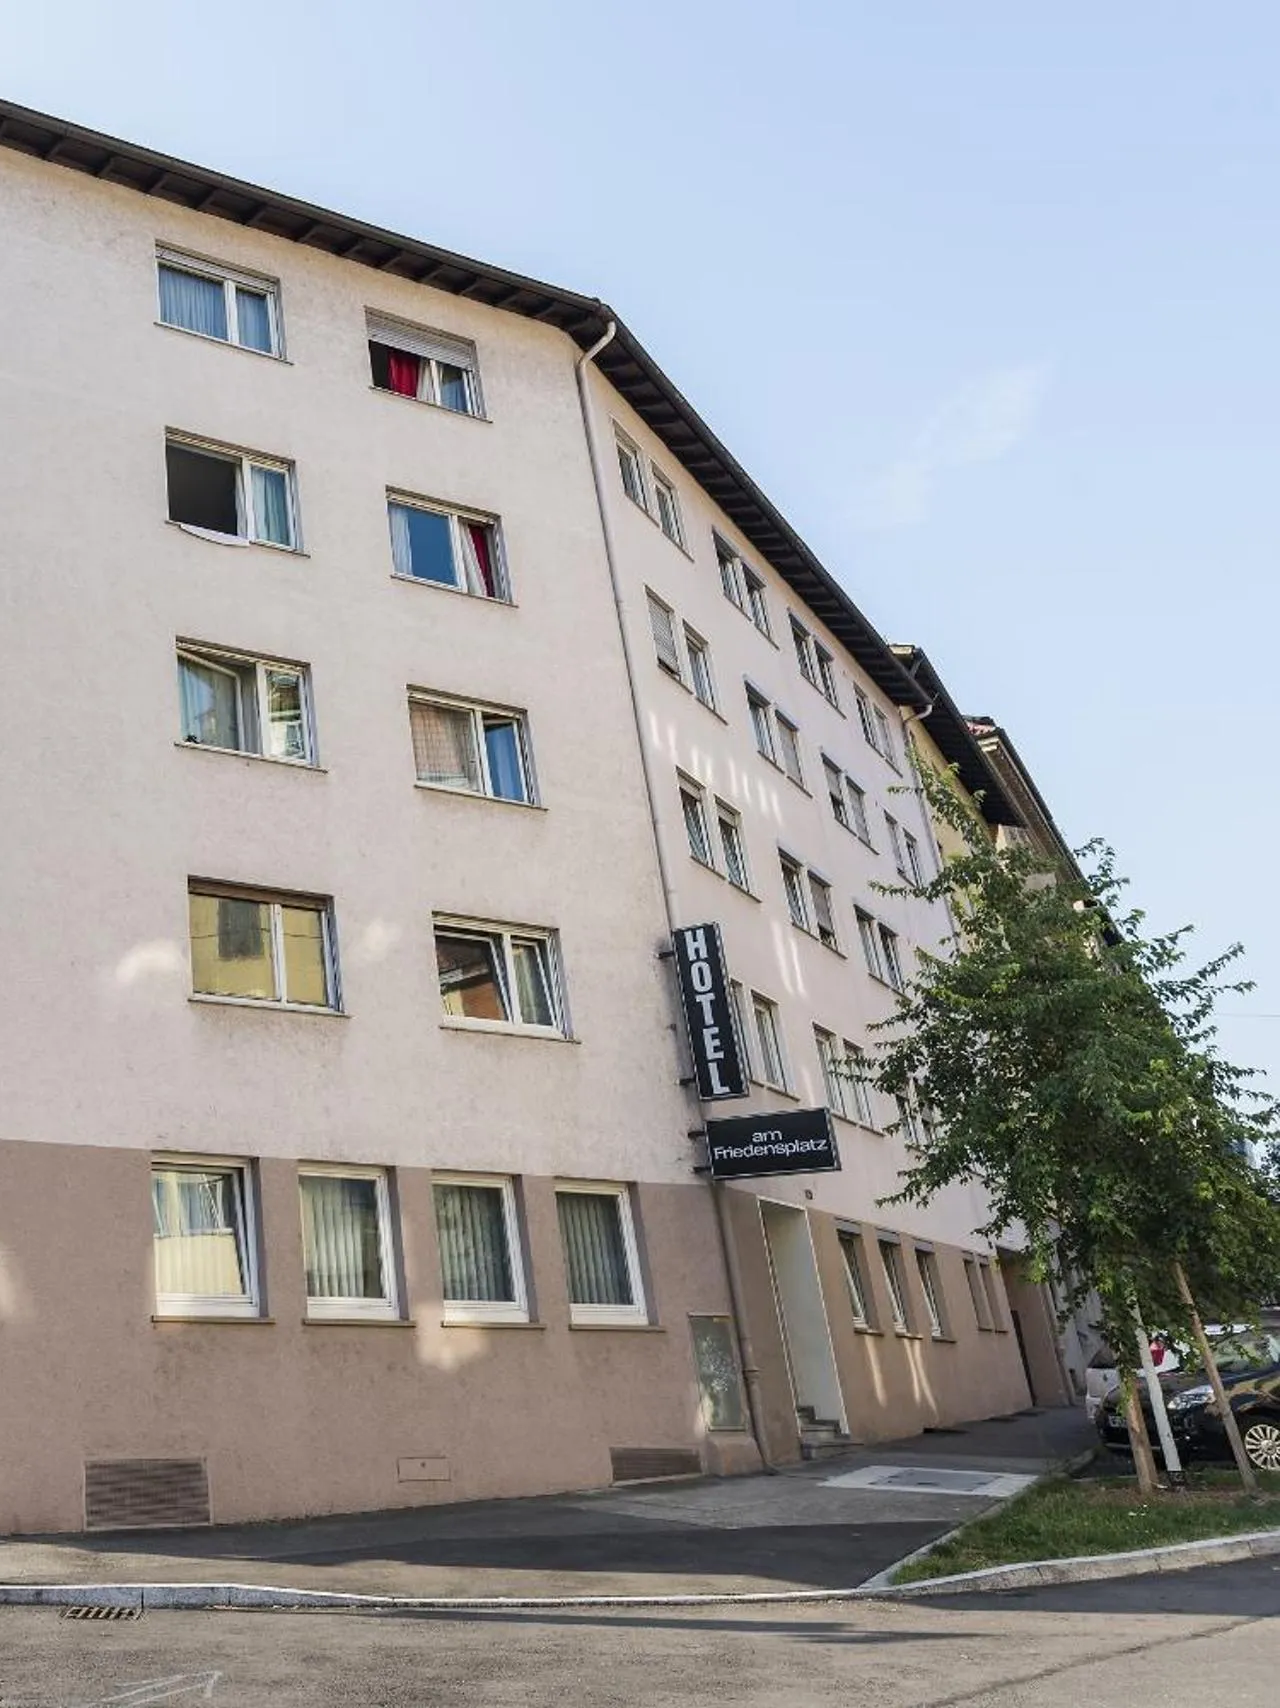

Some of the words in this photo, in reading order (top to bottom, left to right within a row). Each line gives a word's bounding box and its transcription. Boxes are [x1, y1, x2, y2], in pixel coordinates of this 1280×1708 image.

[684, 928, 730, 1095] HOTEL
[751, 1130, 783, 1143] am
[713, 1139, 828, 1160] Friedensplatz
